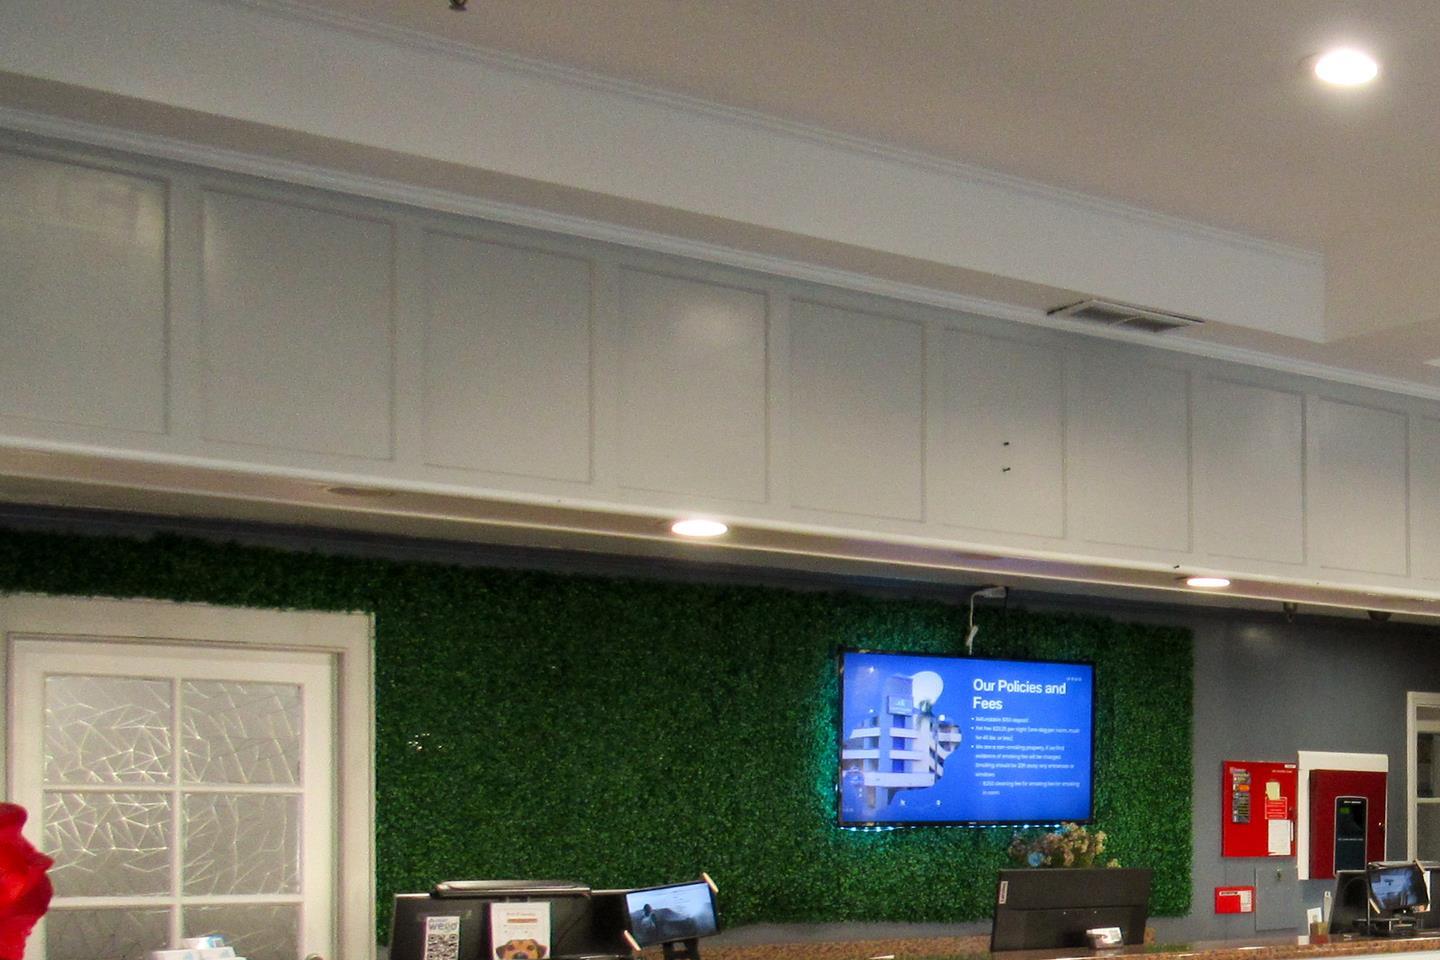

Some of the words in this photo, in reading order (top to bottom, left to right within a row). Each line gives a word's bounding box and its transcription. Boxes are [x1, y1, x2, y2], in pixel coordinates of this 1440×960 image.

[973, 679, 995, 692] Our
[998, 679, 1043, 694] Policies
[1045, 682, 1067, 695] and
[972, 697, 1004, 710] Fees
